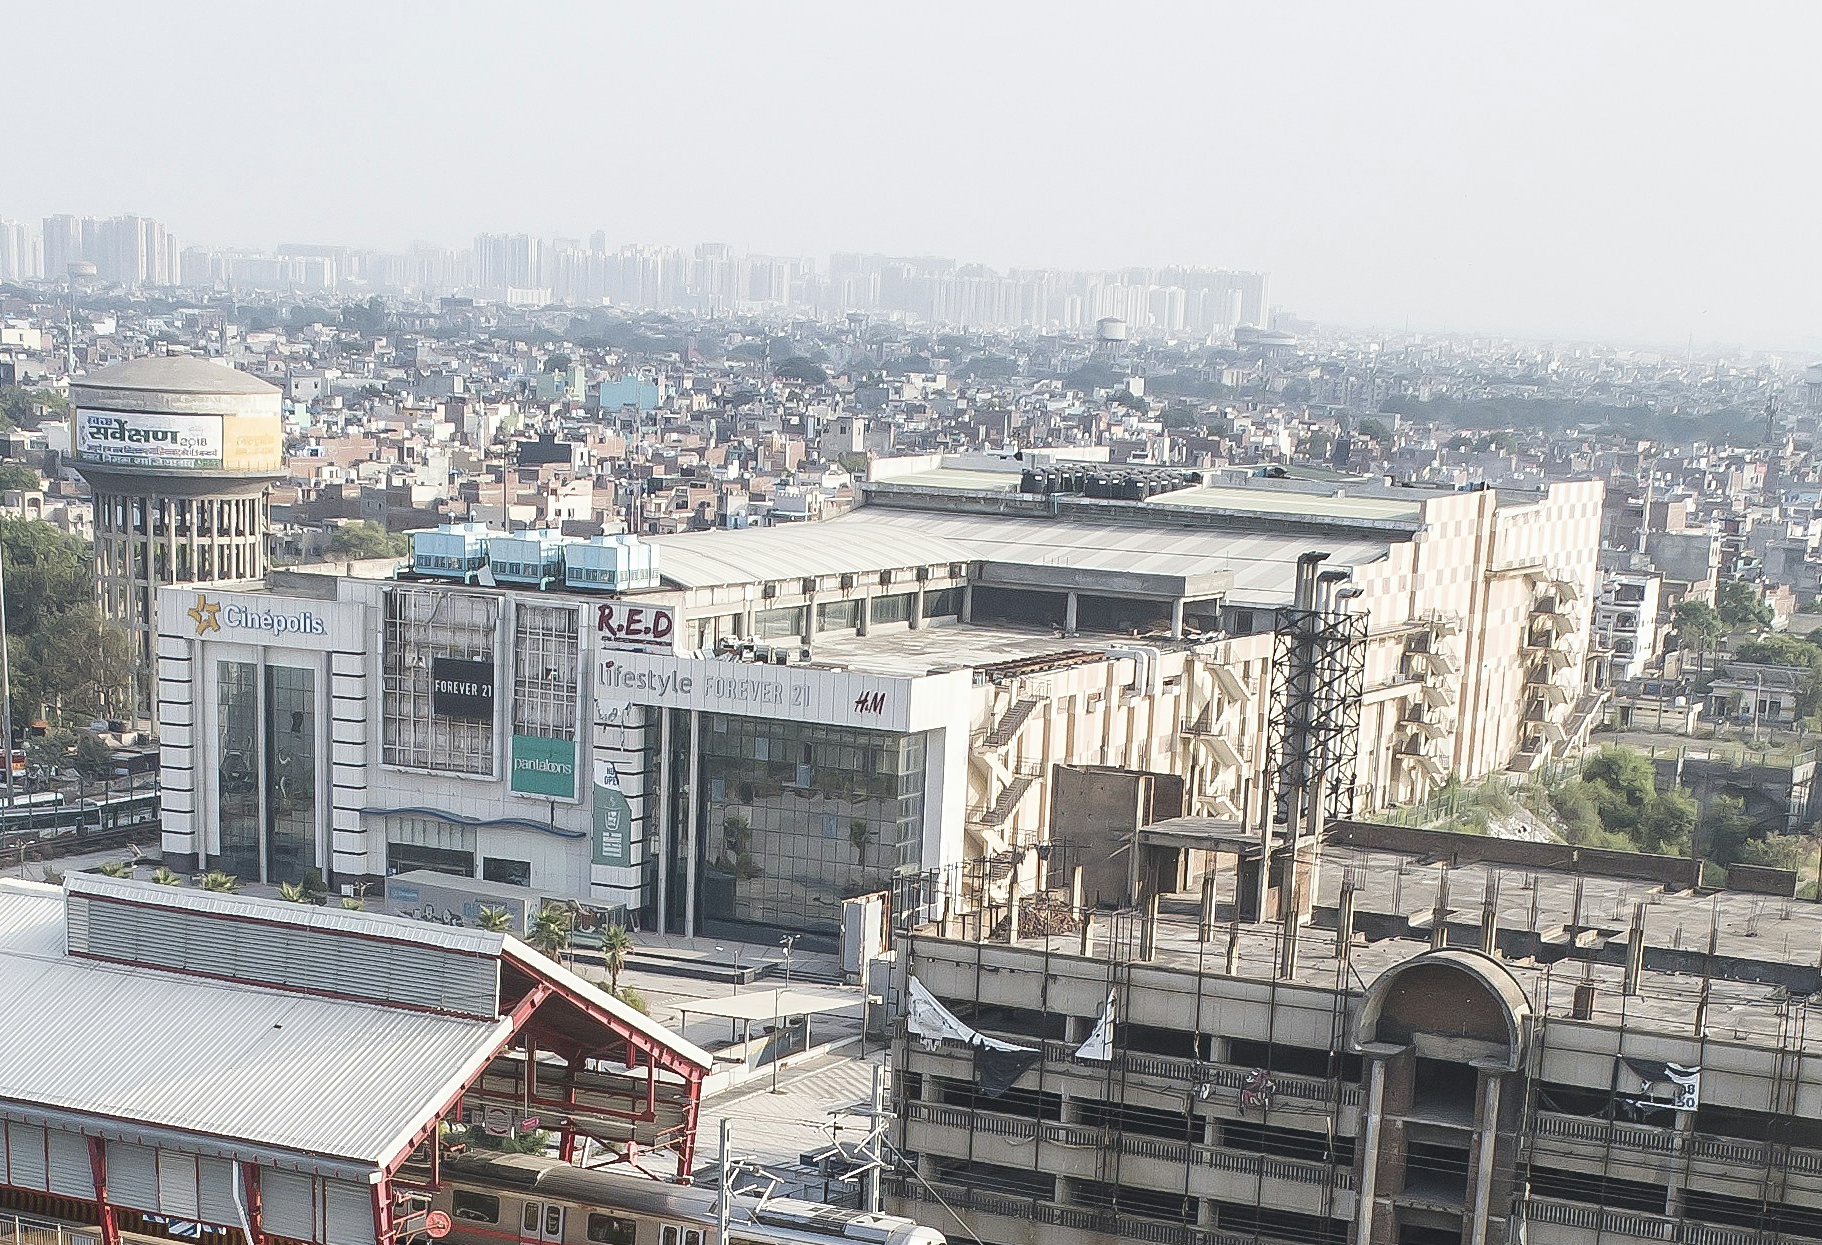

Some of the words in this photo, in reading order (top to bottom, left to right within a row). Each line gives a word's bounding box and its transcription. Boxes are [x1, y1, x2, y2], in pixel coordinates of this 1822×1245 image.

[223, 604, 325, 636] Cinépolis
[435, 680, 478, 696] FOREVER
[482, 685, 492, 698] 21
[599, 661, 692, 697] lifestyle
[705, 676, 783, 705] FOREVER
[792, 684, 810, 707] 21
[514, 758, 572, 775] pantaloons
